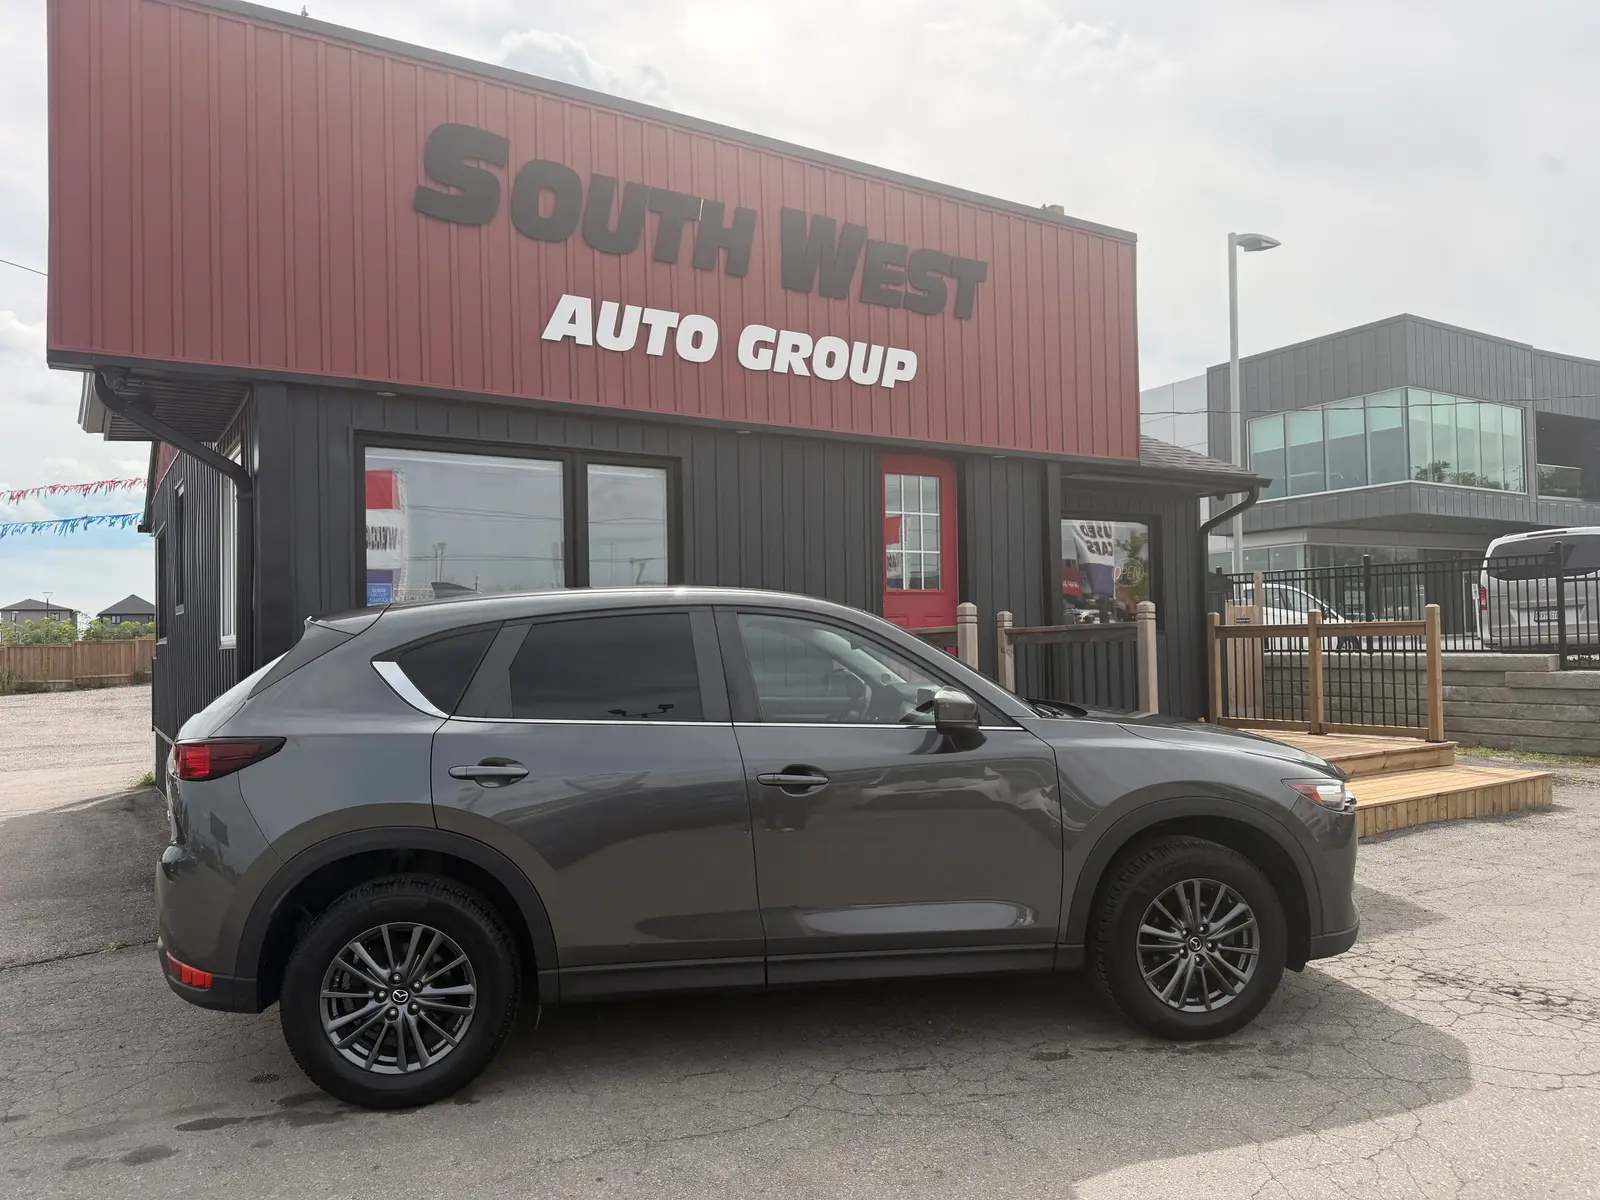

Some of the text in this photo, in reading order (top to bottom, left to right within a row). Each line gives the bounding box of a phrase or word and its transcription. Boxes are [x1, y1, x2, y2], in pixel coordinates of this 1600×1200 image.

[413, 123, 988, 321] SOUTH WEST
[541, 294, 918, 388] AUTO GROUP
[1113, 565, 1141, 581] OPEN
